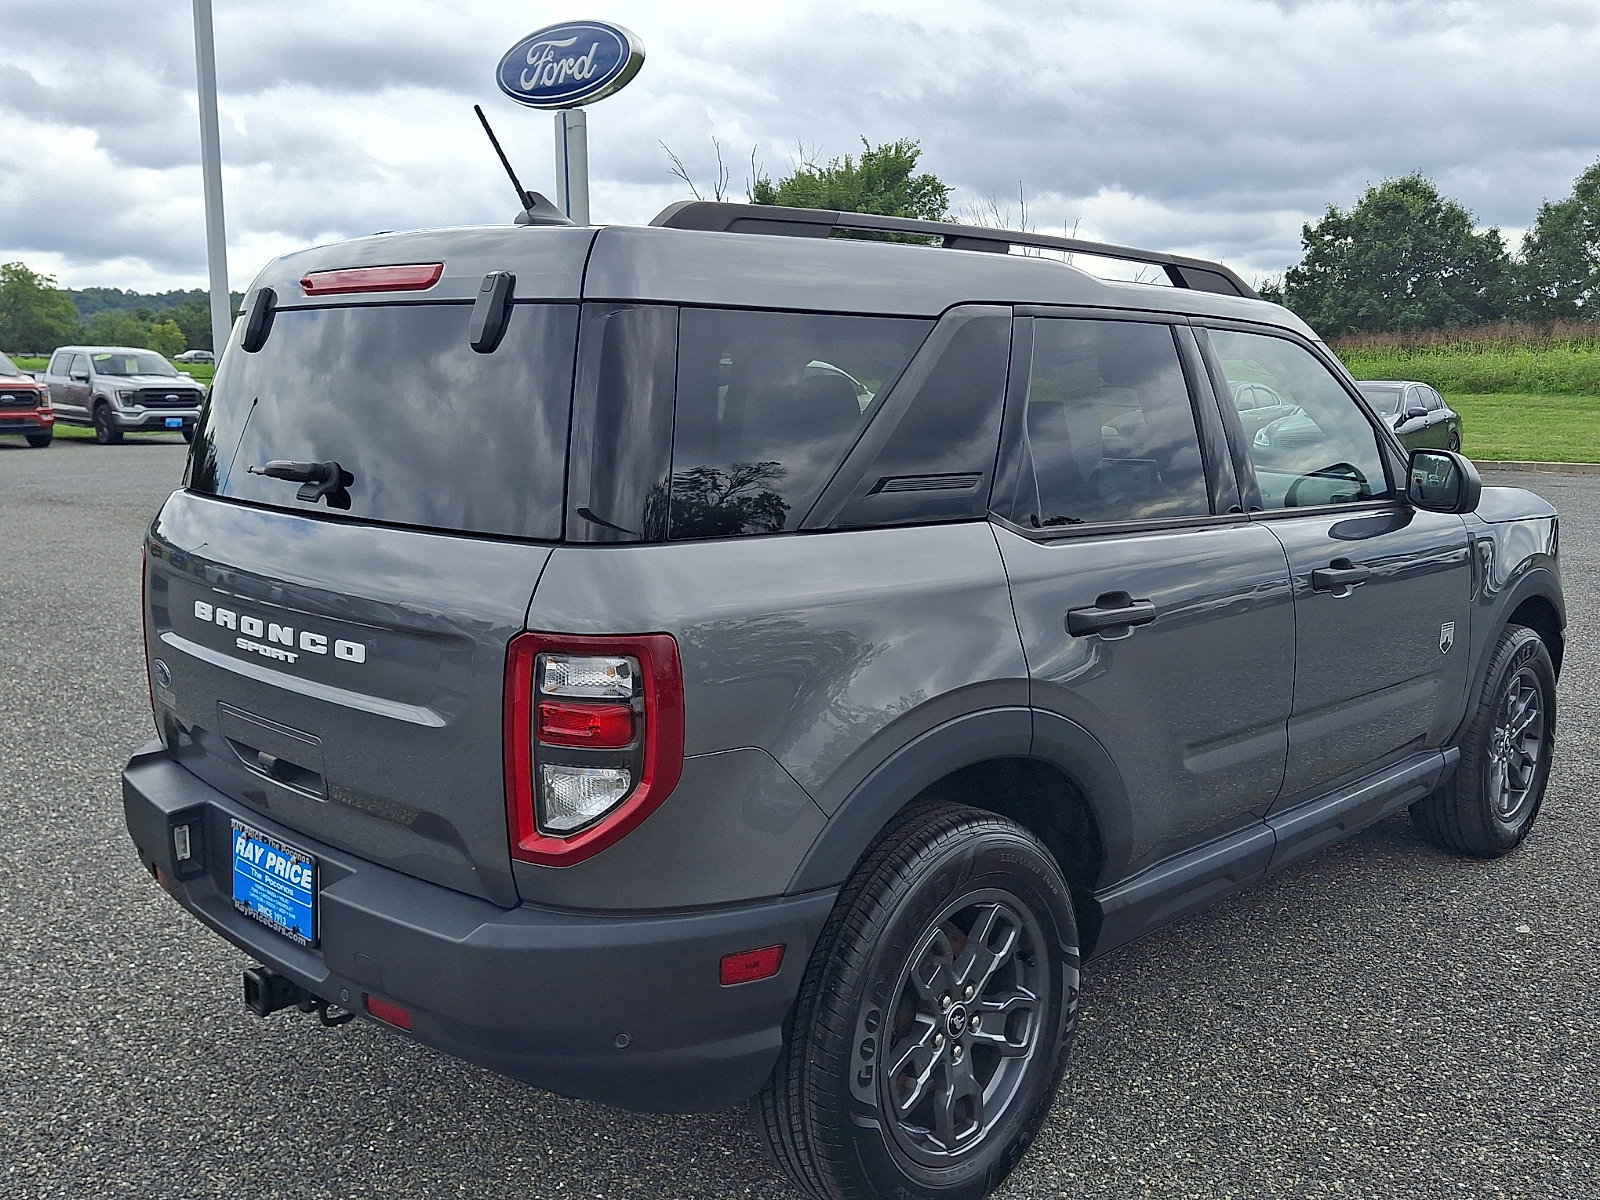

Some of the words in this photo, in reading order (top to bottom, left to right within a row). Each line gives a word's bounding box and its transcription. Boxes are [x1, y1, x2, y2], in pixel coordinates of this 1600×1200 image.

[520, 36, 600, 91] Ford
[194, 600, 366, 664] BRONCO
[235, 637, 299, 664] SPORT
[235, 836, 264, 864] RAY
[265, 852, 312, 889] PRICE
[267, 838, 280, 851] The
[281, 844, 310, 864] Poconos
[251, 867, 263, 880] The
[264, 875, 294, 896] Poconos
[234, 901, 307, 946] RayPriceCars.com
[257, 903, 273, 919] SINCE
